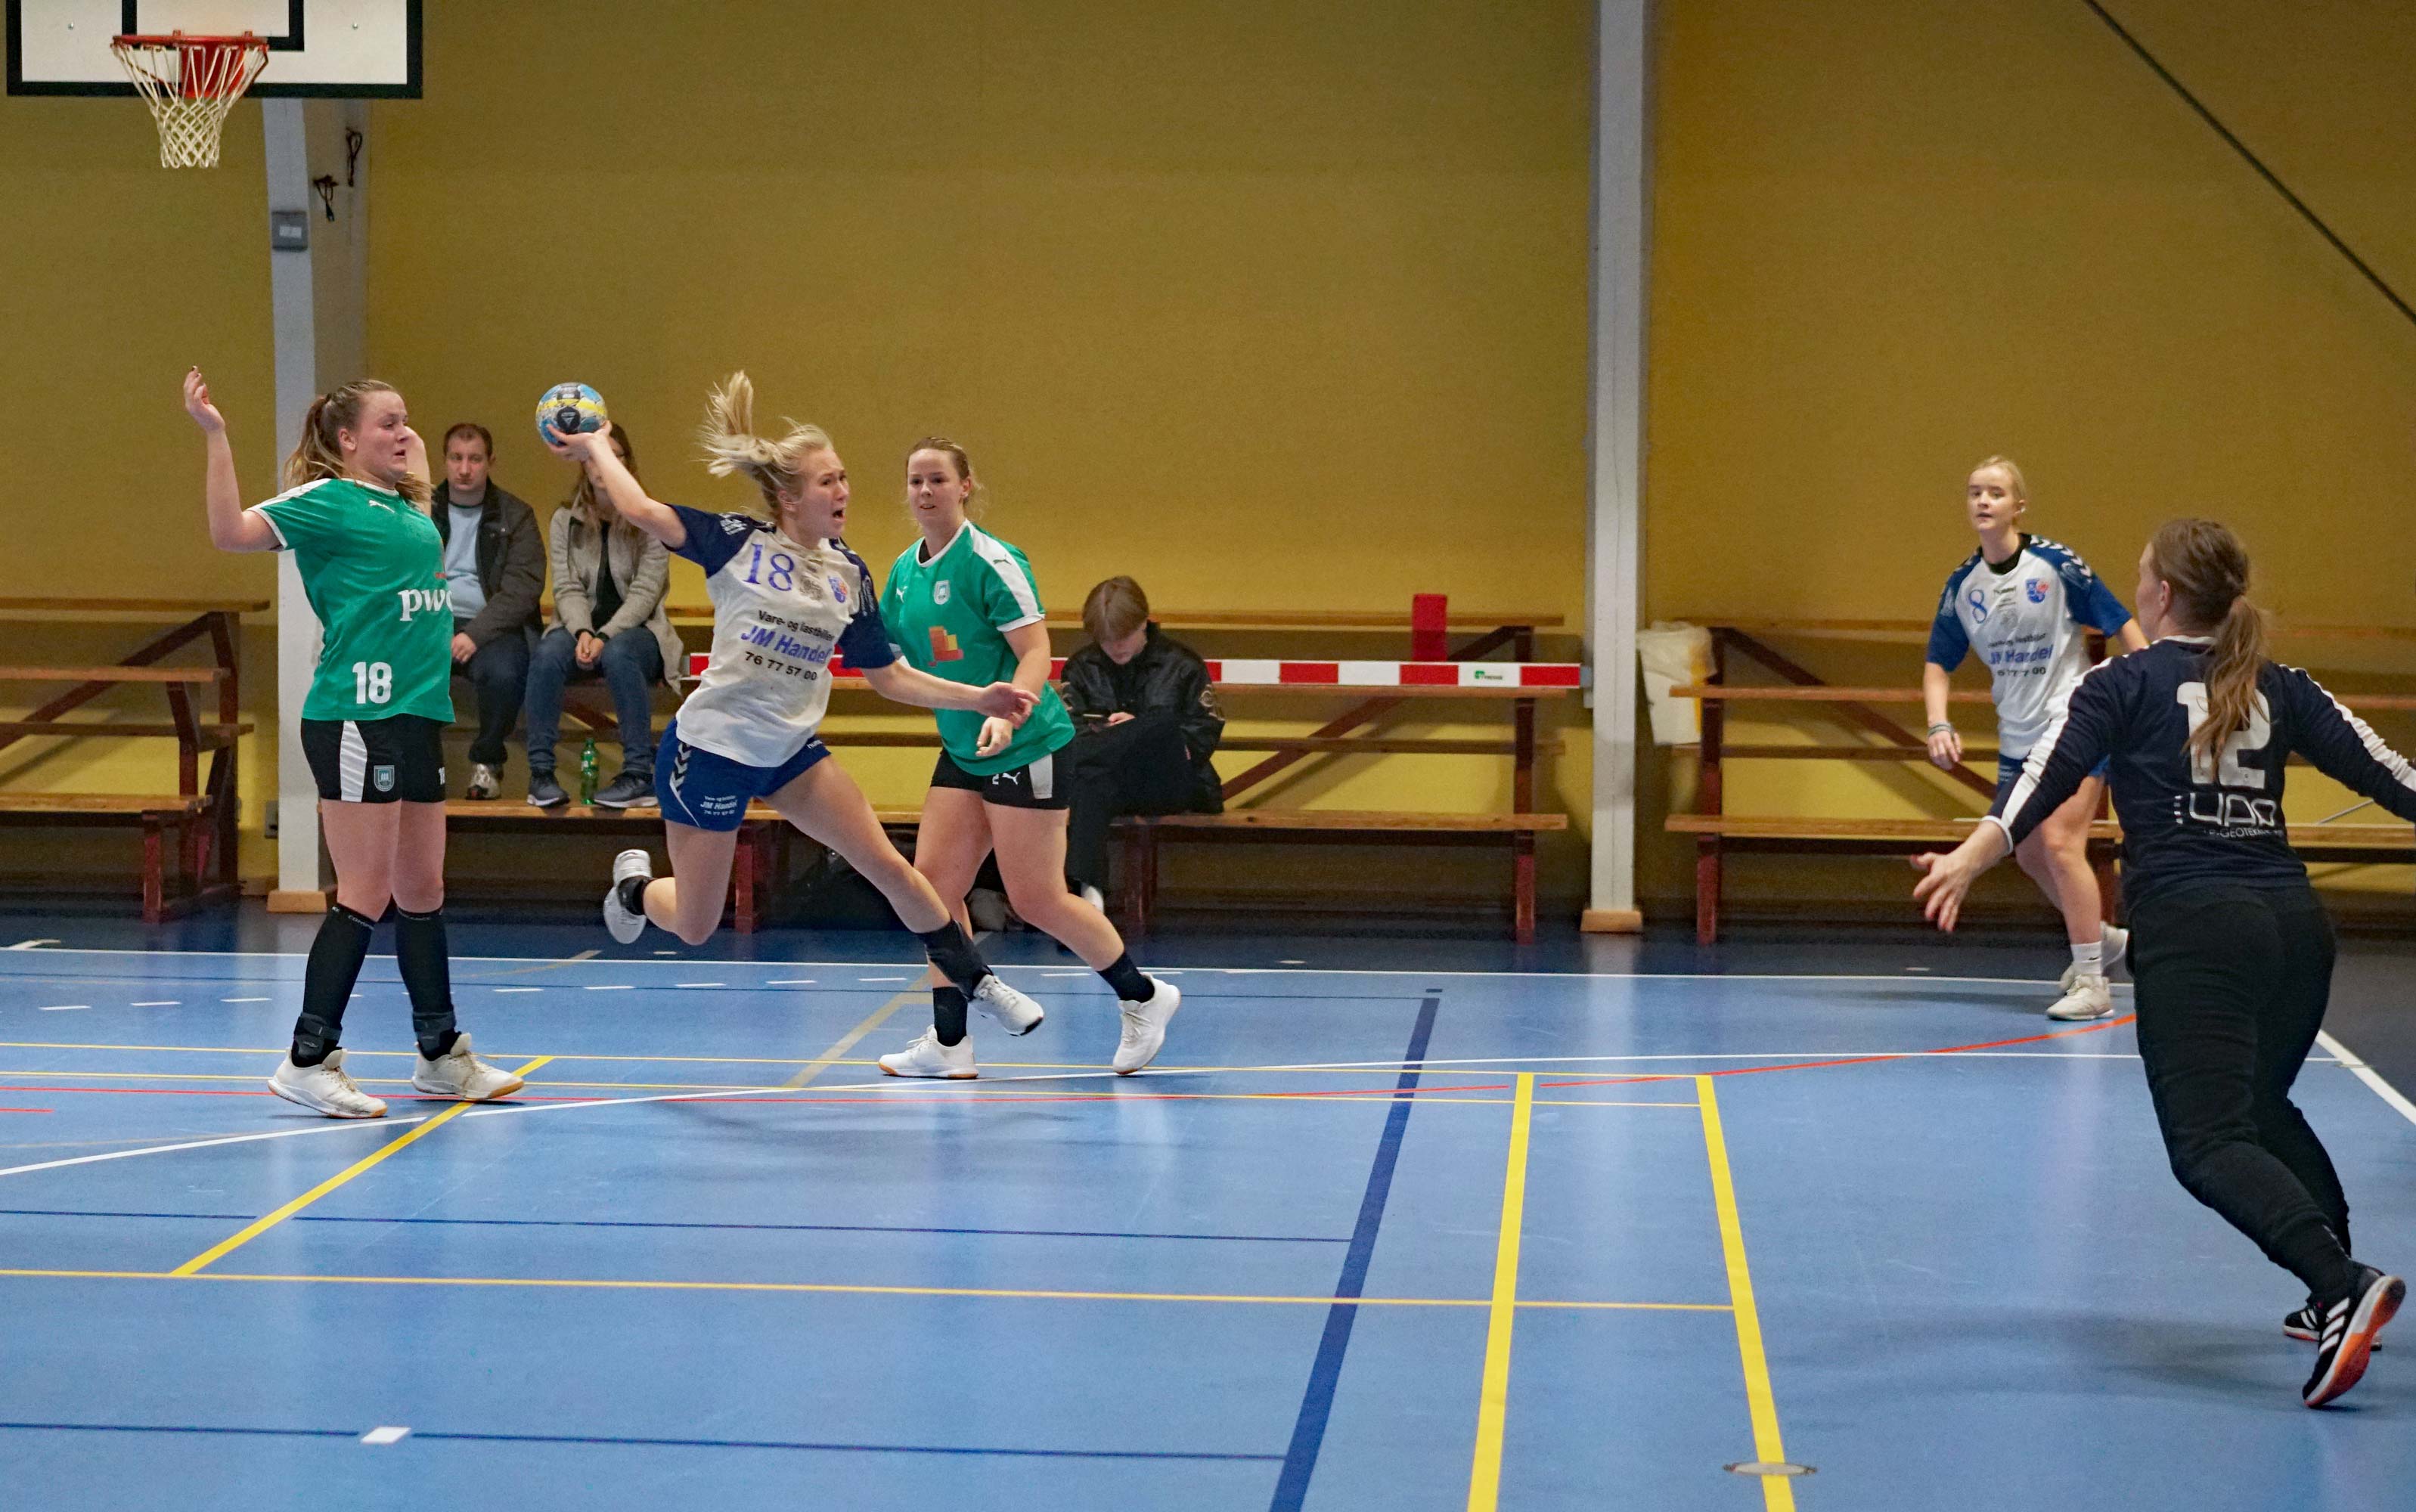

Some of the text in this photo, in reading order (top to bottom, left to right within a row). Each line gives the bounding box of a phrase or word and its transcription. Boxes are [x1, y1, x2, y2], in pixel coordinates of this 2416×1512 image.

[743, 543, 794, 591] 18
[758, 610, 786, 625] Vare-
[1968, 589, 1987, 624] 8
[740, 625, 775, 647] JM
[746, 651, 817, 680] 76 77 57 00
[352, 662, 392, 705] 18
[2176, 681, 2271, 789] 12
